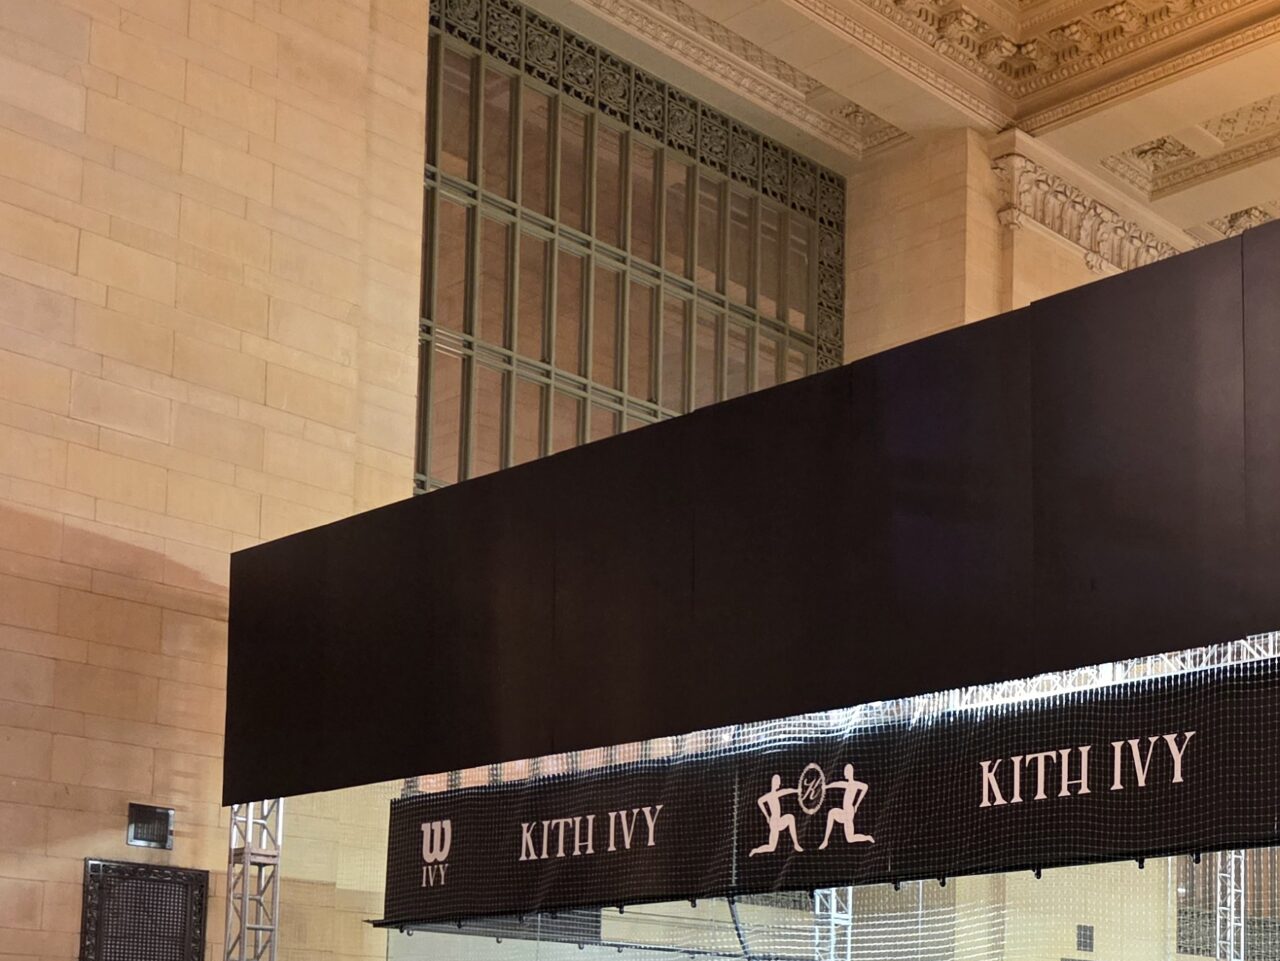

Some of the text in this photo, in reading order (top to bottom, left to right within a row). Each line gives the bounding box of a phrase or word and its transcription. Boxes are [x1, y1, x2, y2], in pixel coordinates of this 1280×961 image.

[979, 731, 1196, 808] KITH IVY
[518, 804, 664, 861] KITH IVY
[421, 863, 448, 888] IVY
